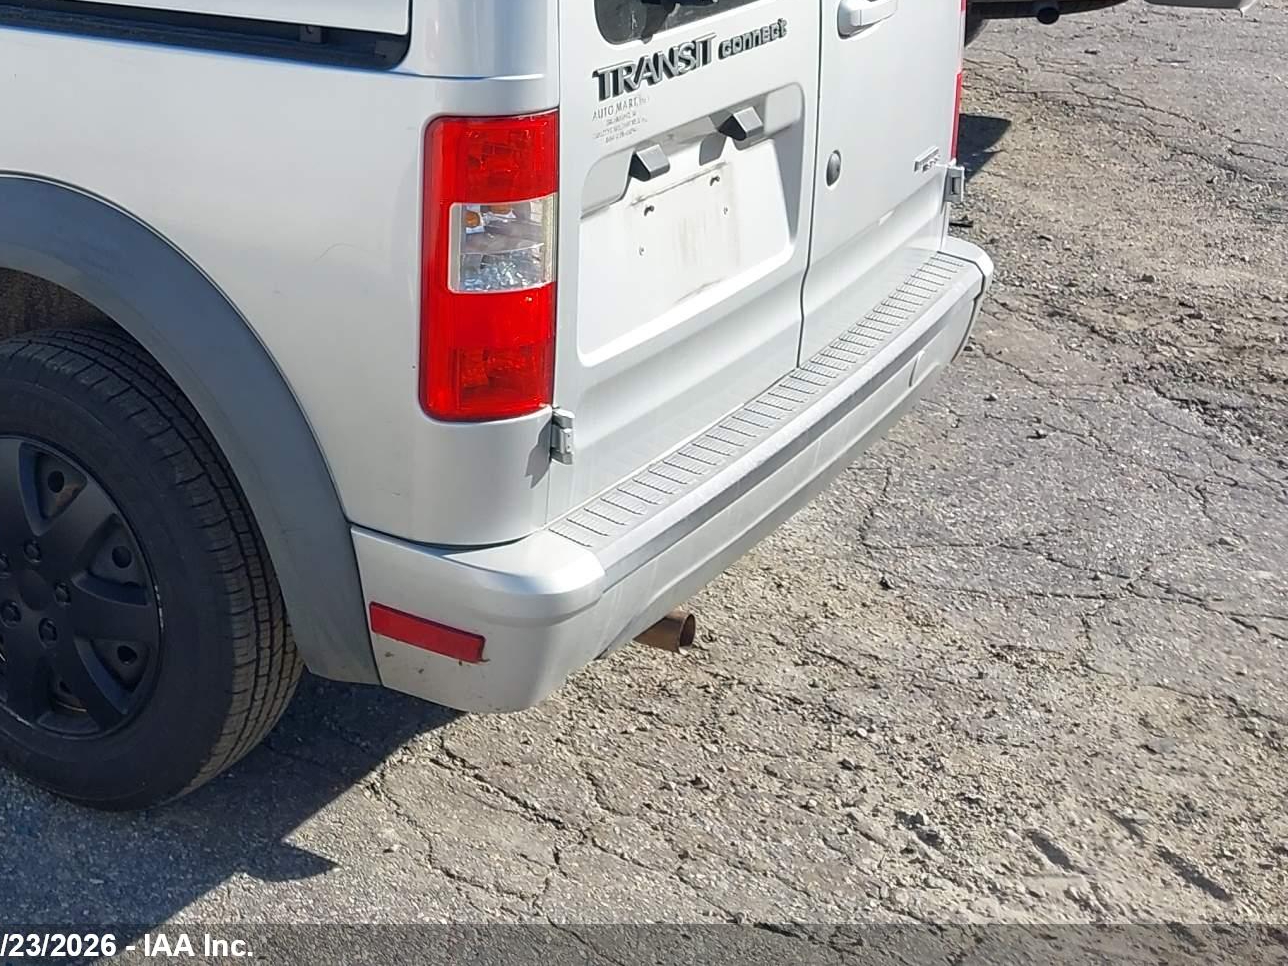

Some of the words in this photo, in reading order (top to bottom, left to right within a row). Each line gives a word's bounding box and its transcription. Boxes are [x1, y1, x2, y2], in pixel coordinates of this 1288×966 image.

[592, 32, 717, 102] TRANSIT
[718, 18, 787, 60] connect
[592, 105, 614, 121] AUTO
